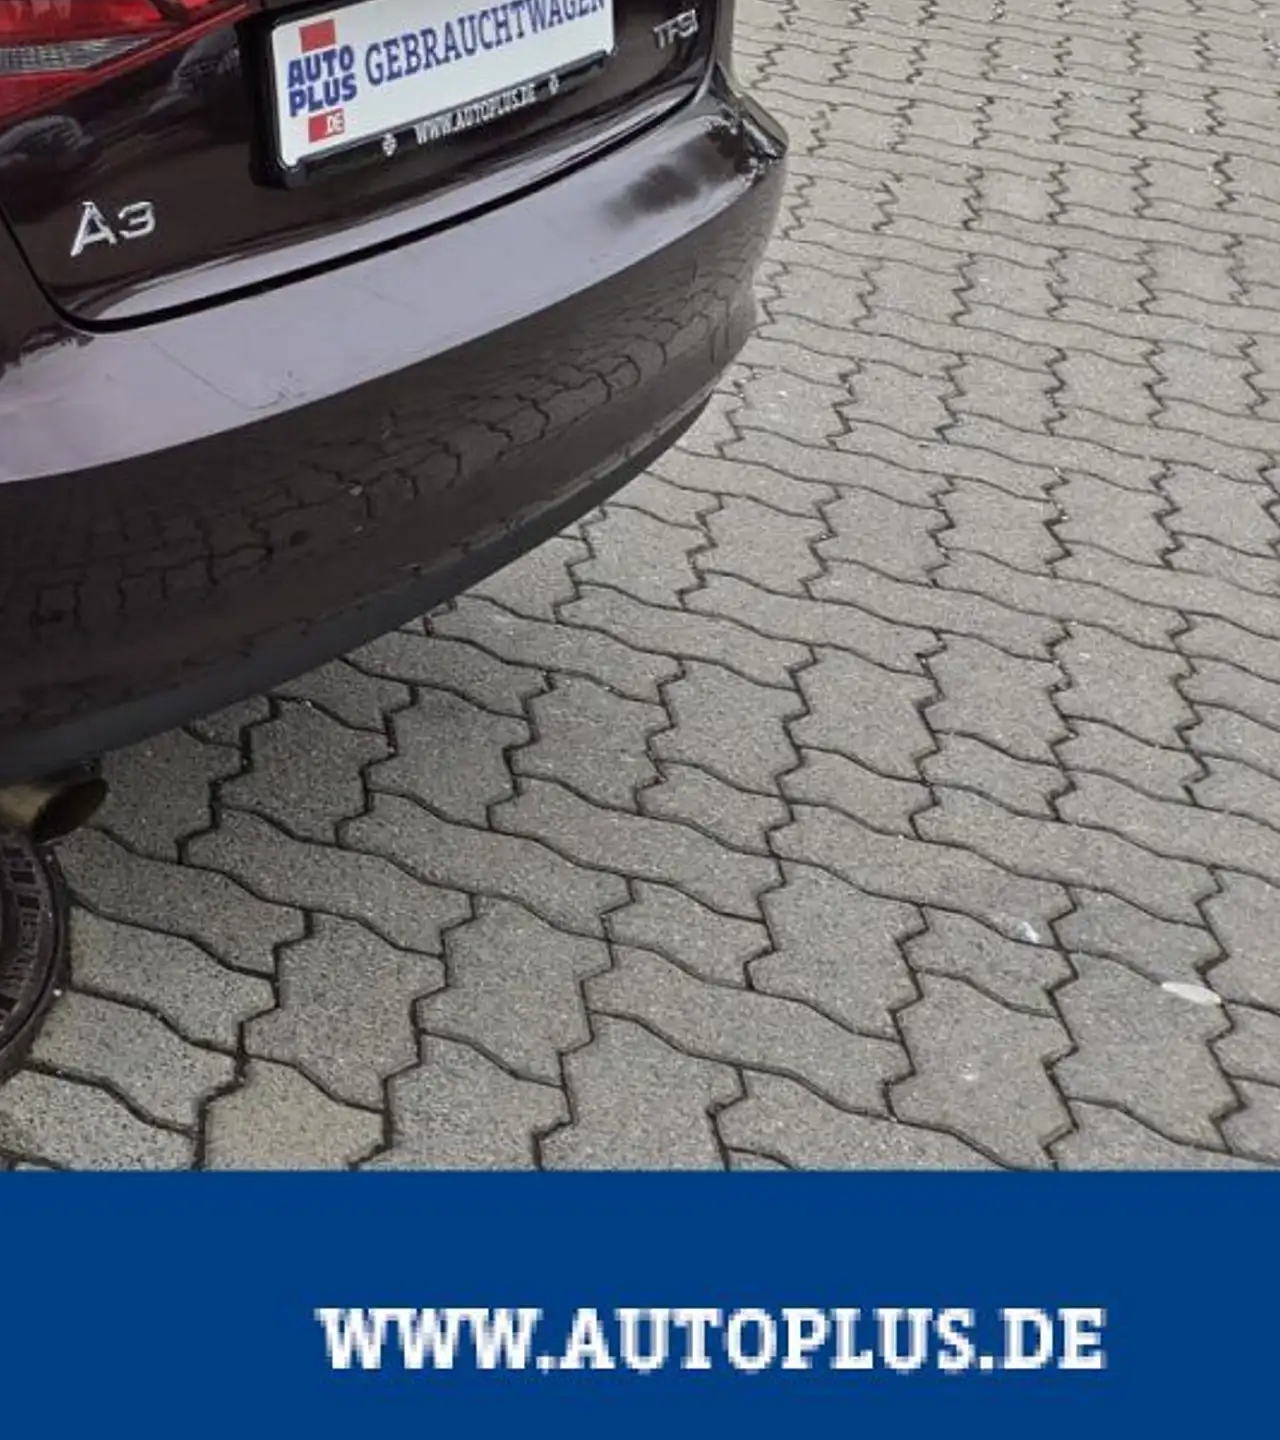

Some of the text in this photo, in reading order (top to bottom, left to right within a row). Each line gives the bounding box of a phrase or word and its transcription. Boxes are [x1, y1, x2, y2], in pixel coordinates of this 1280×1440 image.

[287, 45, 354, 89] AUTO
[288, 72, 357, 117] PLUS
[70, 201, 156, 256] A3
